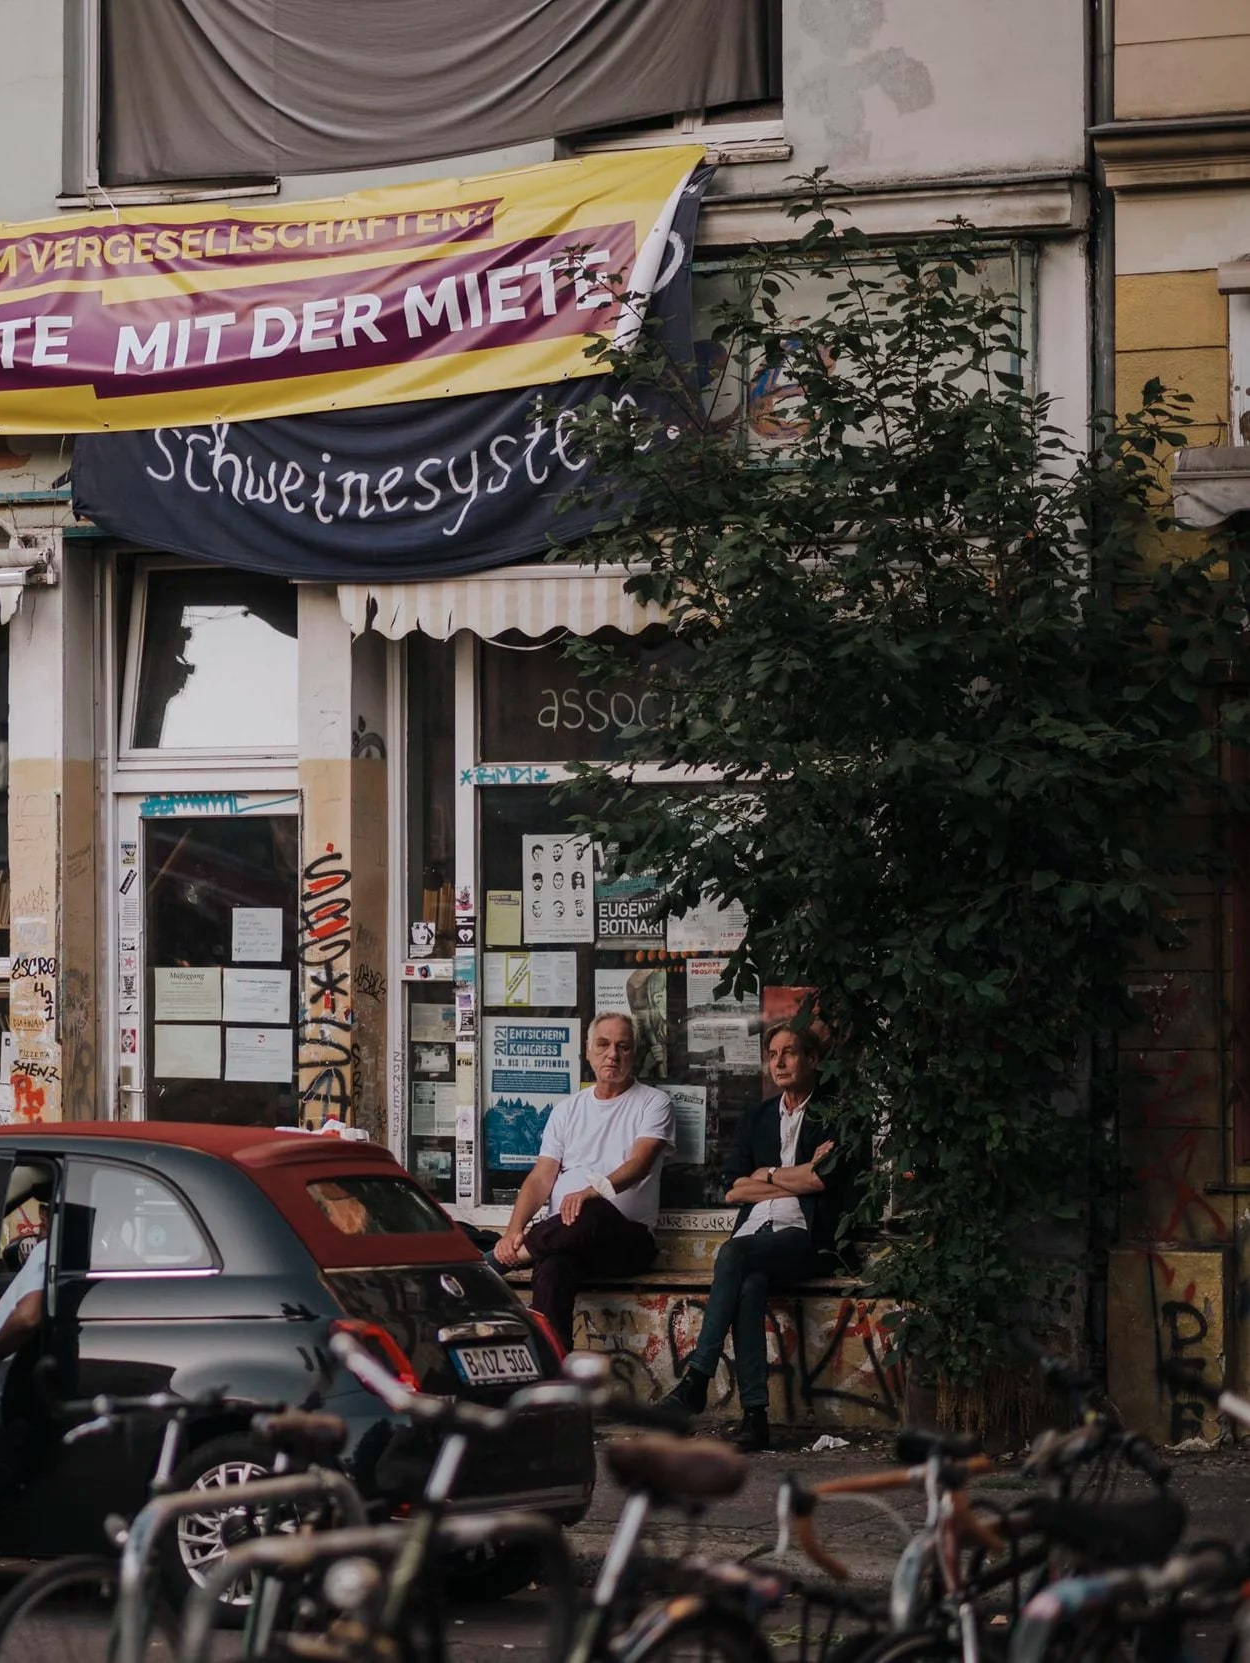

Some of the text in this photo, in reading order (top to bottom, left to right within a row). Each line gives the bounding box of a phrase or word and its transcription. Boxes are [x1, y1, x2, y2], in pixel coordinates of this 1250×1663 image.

[113, 312, 238, 376] MIT
[249, 292, 387, 360] DER
[403, 249, 613, 338] MIETE
[598, 902, 657, 918] EUGEN
[494, 1025, 507, 1055] 2021
[509, 1028, 566, 1041] ENTSICHERN
[509, 1043, 558, 1055] KONGRESS
[534, 1059, 570, 1068] SEPTEMBER
[463, 1351, 479, 1377] B
